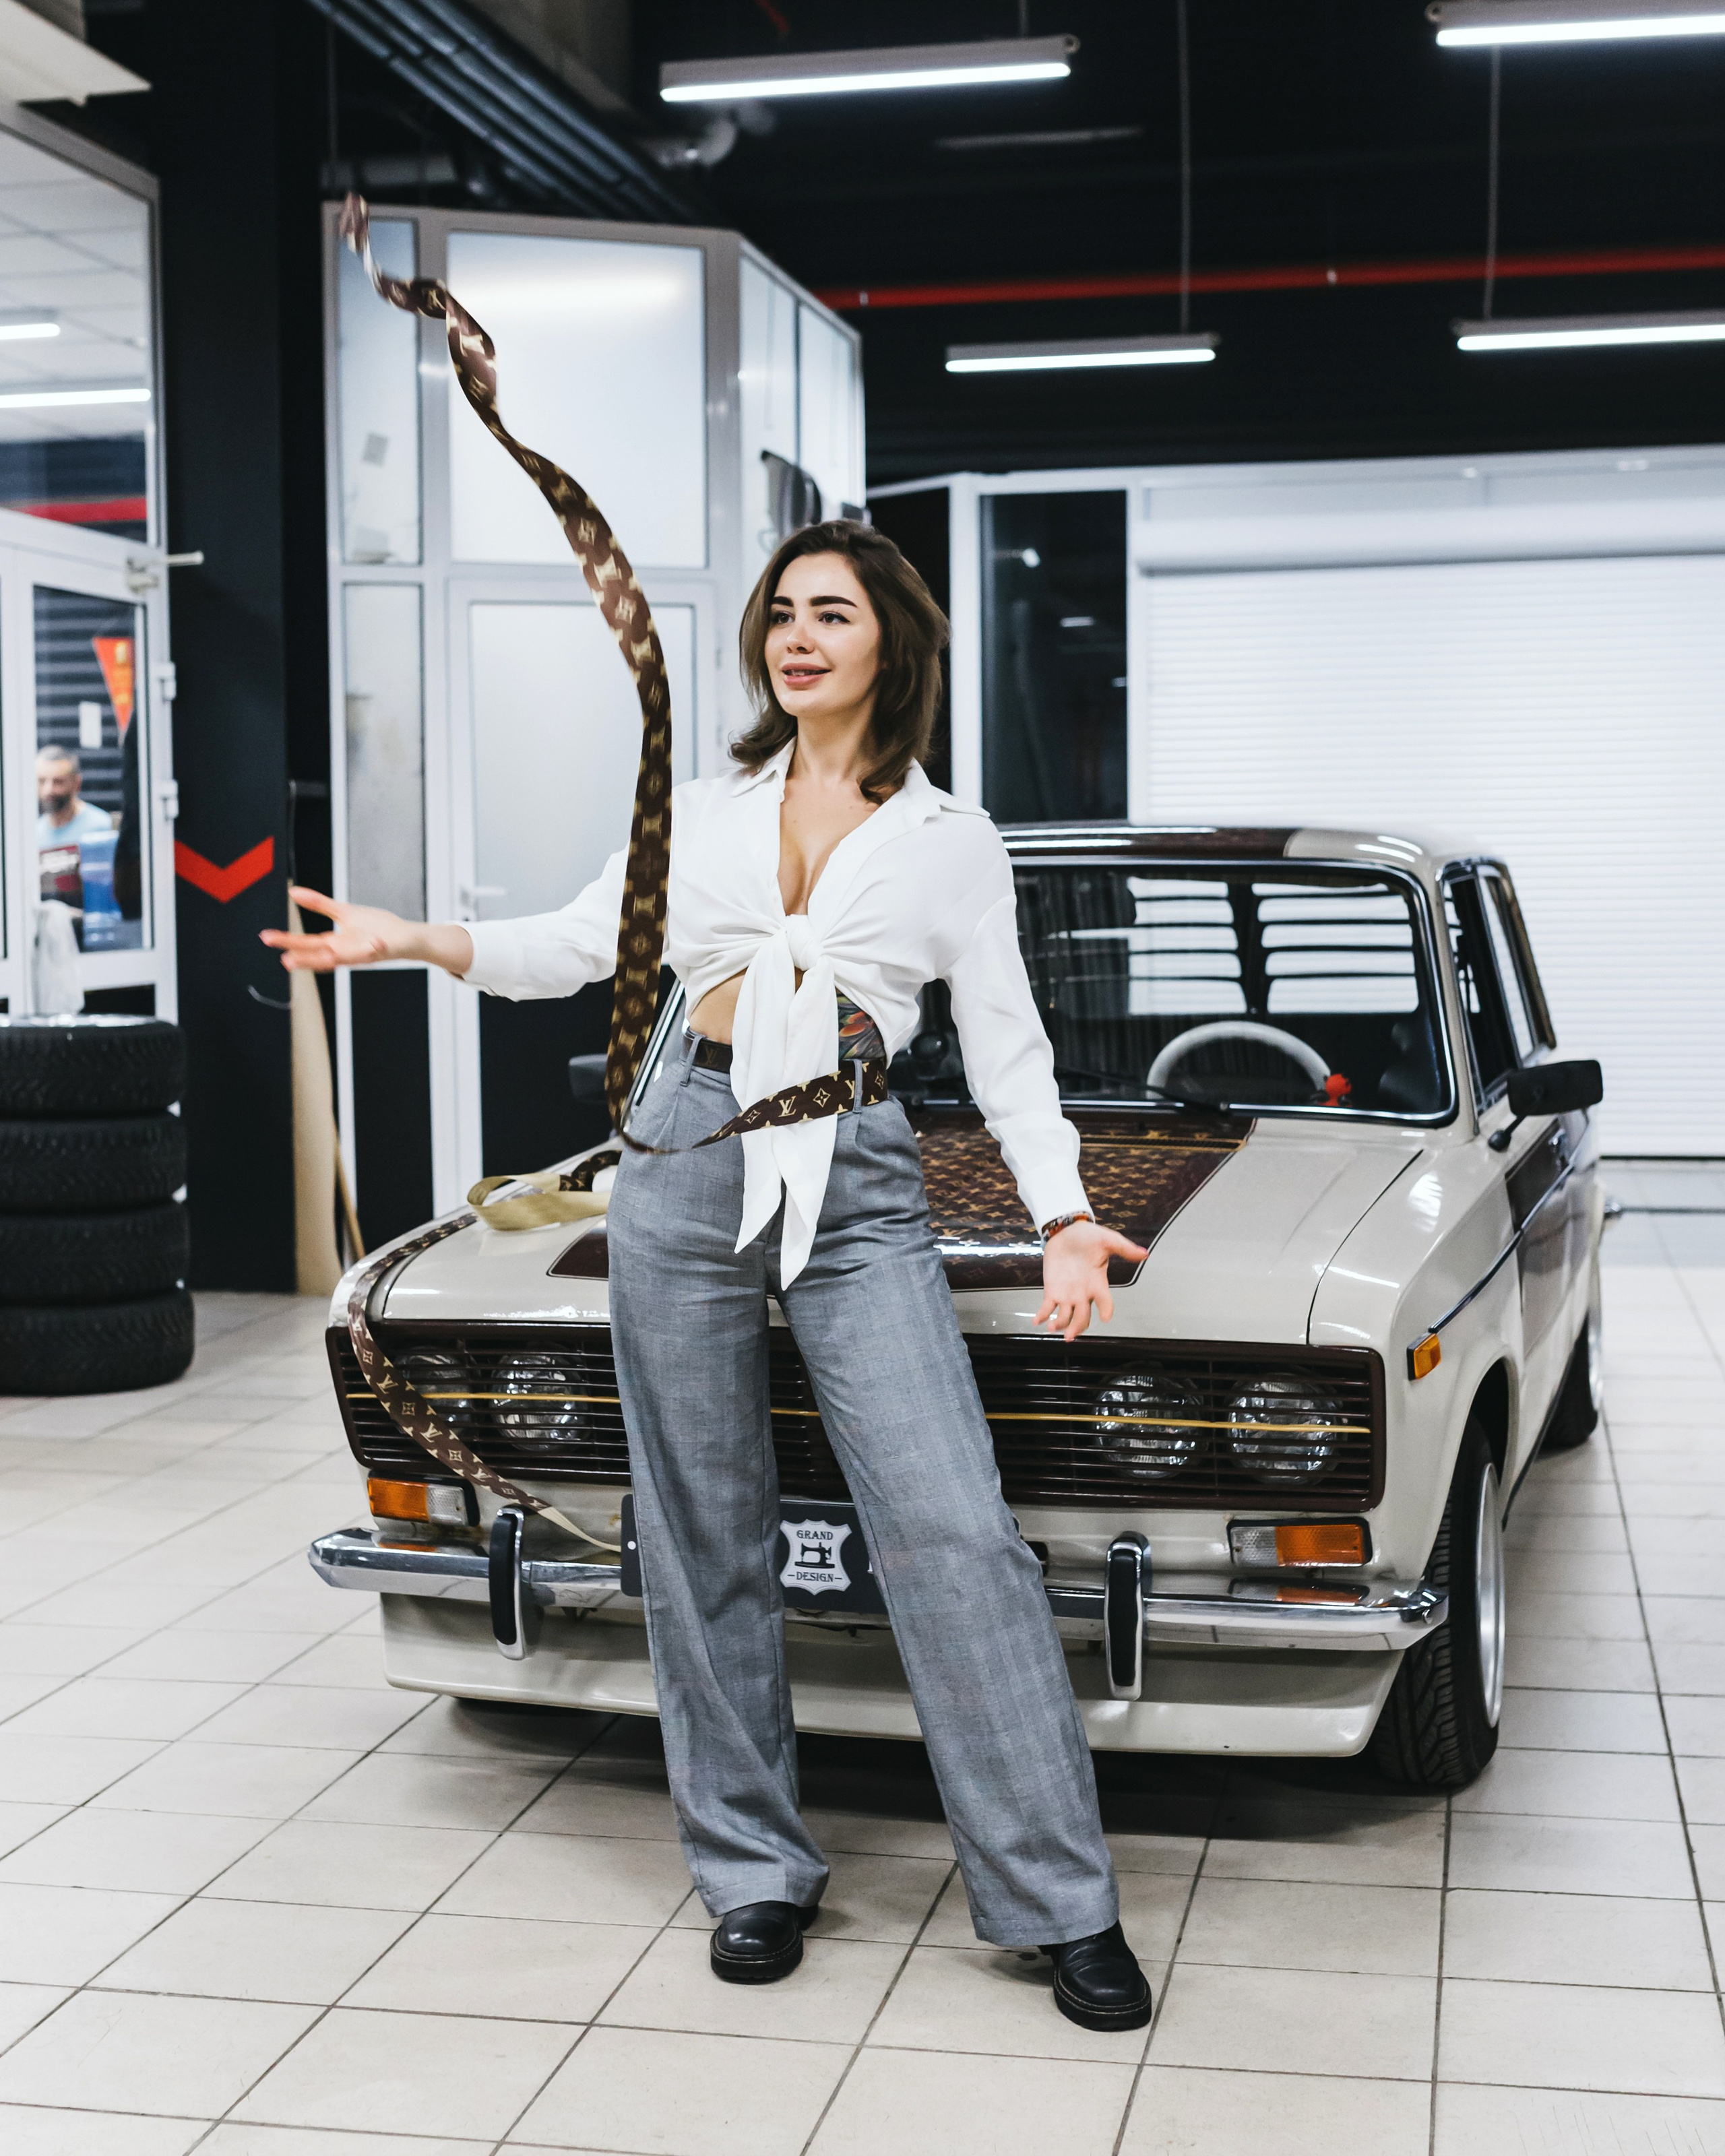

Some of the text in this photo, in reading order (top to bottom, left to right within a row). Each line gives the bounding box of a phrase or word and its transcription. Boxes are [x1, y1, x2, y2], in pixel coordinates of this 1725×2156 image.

[778, 1096, 796, 1118] LV
[796, 1530, 834, 1540] GRAND
[796, 1572, 834, 1582] DESIGN
